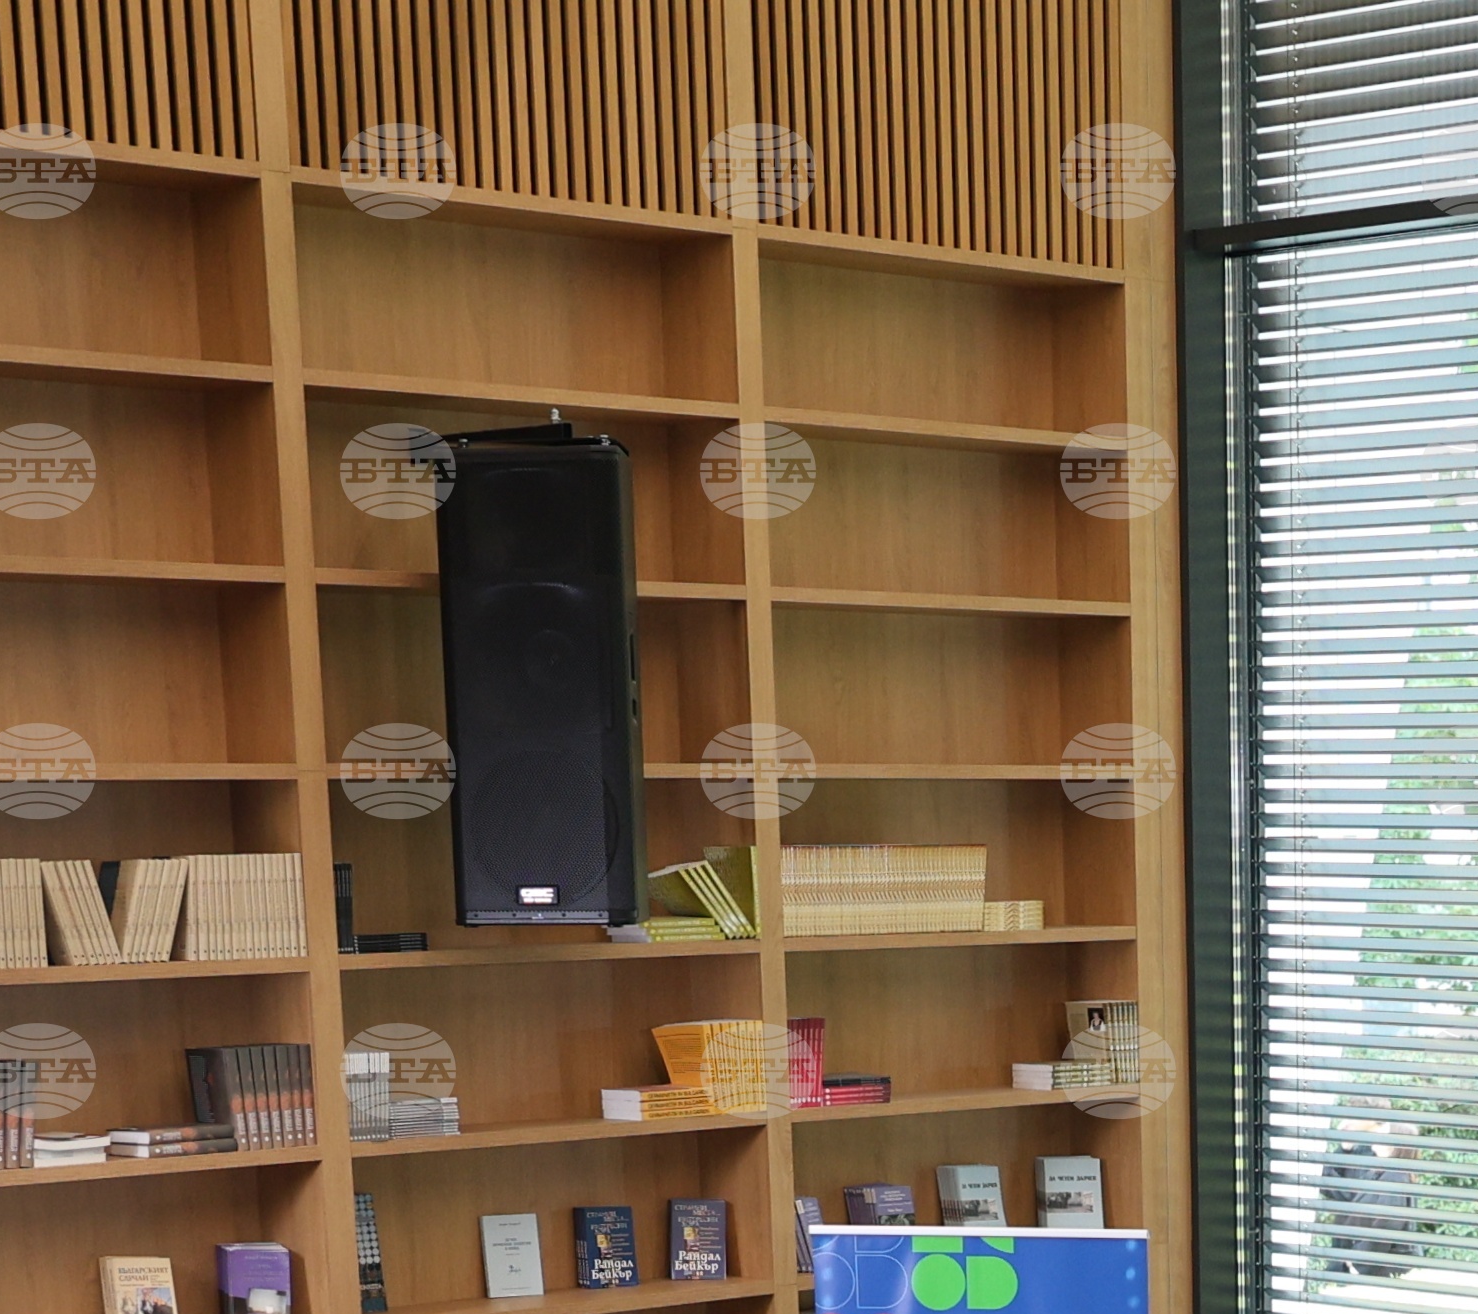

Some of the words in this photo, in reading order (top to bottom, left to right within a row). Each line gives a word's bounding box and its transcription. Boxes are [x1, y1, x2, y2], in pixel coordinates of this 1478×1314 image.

[679, 1251, 722, 1264] Рандал
[594, 1259, 634, 1271] Рандал
[675, 1261, 719, 1274] Бейкър
[591, 1269, 632, 1281] Бейкър
